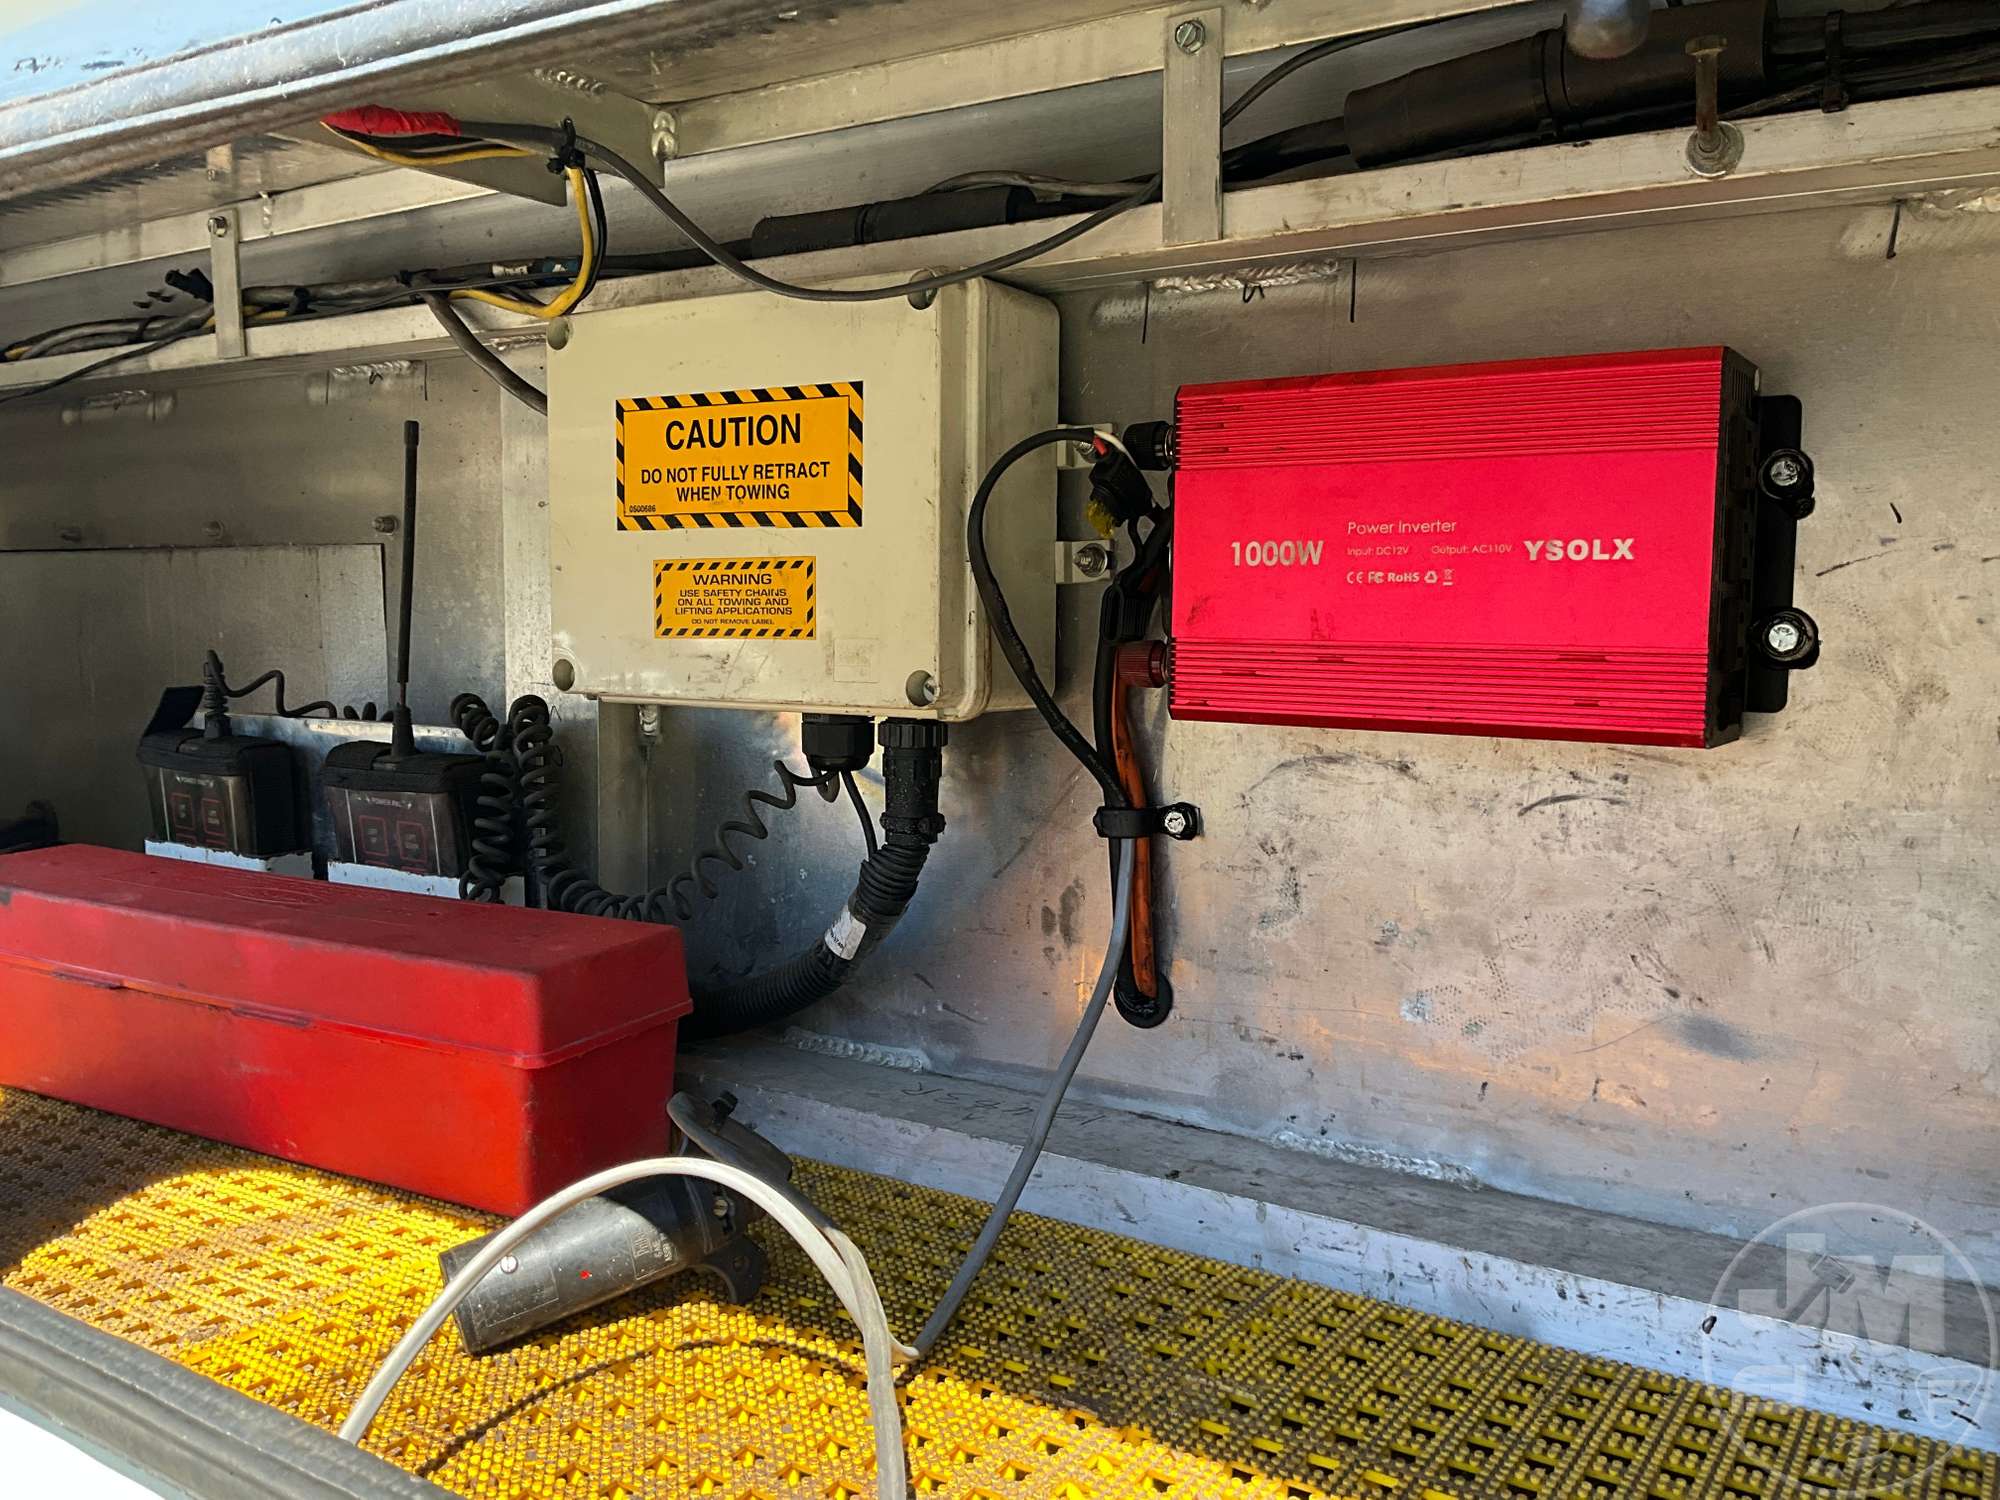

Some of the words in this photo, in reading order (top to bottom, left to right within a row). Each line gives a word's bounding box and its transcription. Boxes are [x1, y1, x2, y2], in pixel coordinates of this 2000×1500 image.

[666, 413, 801, 450] CAUTION
[642, 468, 662, 484] DO
[667, 467, 697, 482] NOT
[702, 464, 749, 482] FULLY
[754, 461, 830, 479] RETRACT
[677, 486, 721, 501] WHEN
[727, 484, 789, 499] TOWING
[1348, 522, 1393, 535] Power
[1399, 521, 1456, 533] Inverter
[1231, 540, 1324, 567] 1000W
[1376, 546, 1409, 555] DC12V
[1472, 544, 1512, 554] AC110V
[1523, 538, 1635, 560] YSOLX
[693, 574, 772, 585] WARNING
[1388, 572, 1420, 583] RoHS
[680, 589, 699, 597] USE
[704, 589, 742, 597] SAFETY
[746, 589, 786, 597] CHAINS
[678, 598, 692, 606] ON
[697, 598, 714, 606] ALL
[718, 598, 761, 606] TOWING
[675, 607, 712, 615] LIFTING
[716, 607, 792, 615] APPLICATIONS
